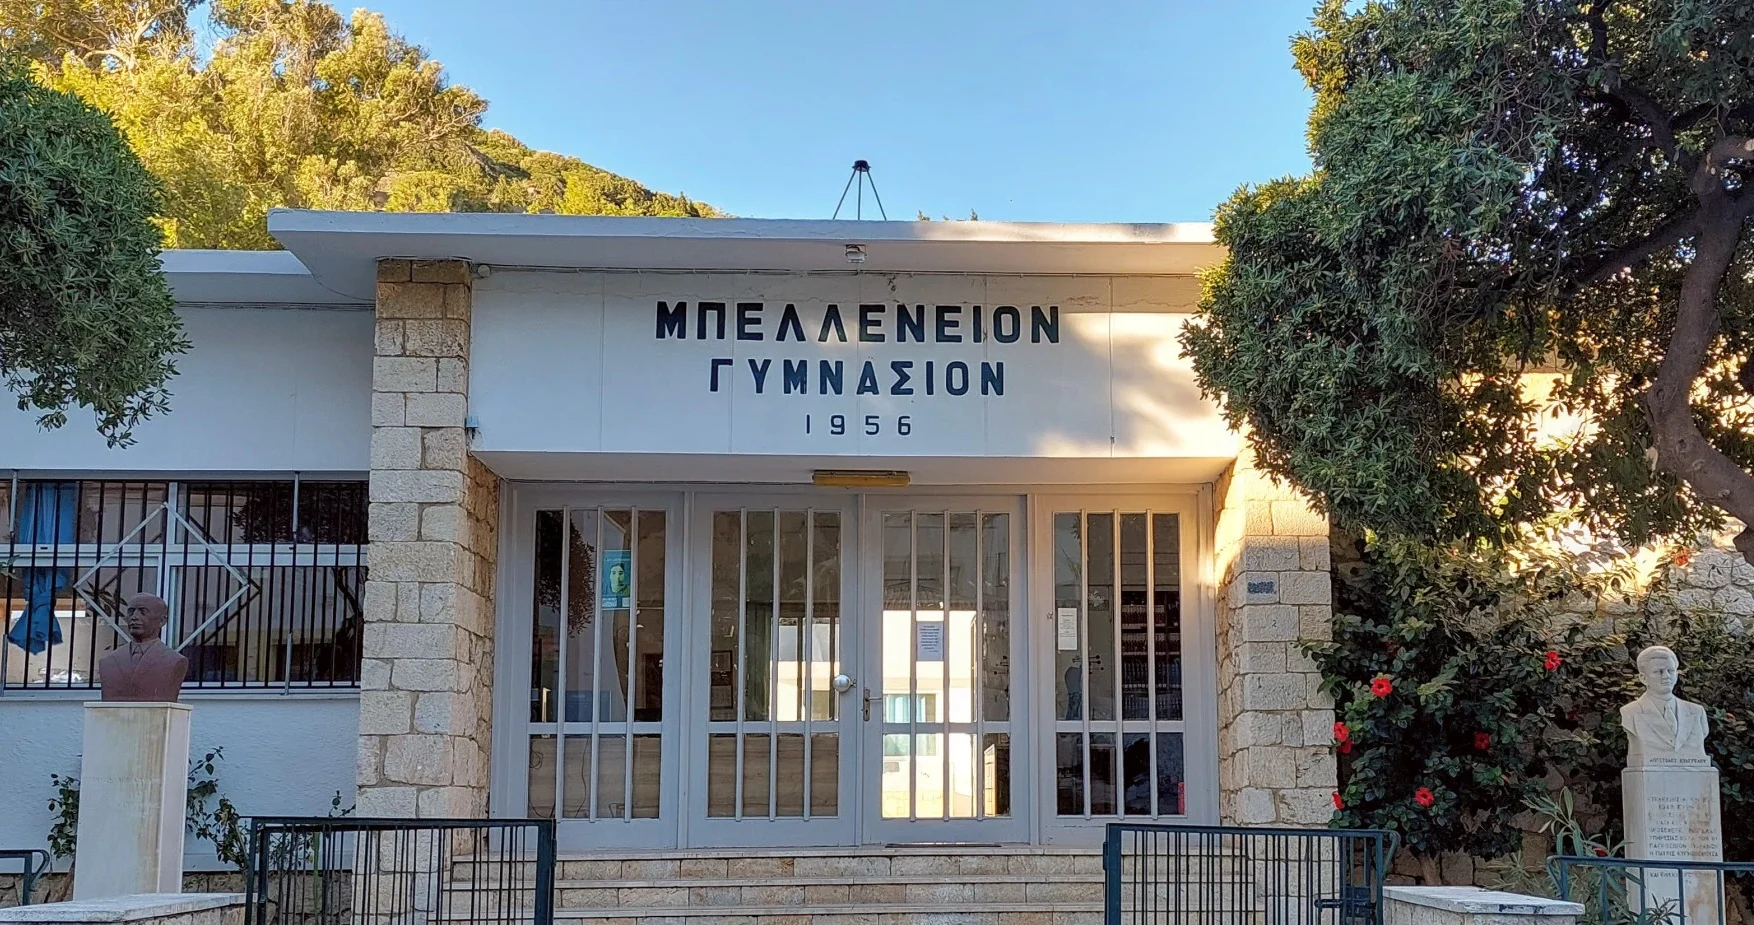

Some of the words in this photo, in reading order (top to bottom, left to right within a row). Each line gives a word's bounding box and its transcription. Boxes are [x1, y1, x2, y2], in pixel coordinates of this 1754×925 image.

[655, 300, 1060, 344] ΜΠΕΛΛΕΝΕΙΟΝ
[709, 358, 1005, 396] ΓΥΜΝΑΣΙΟΝ
[805, 414, 912, 436] 1956
